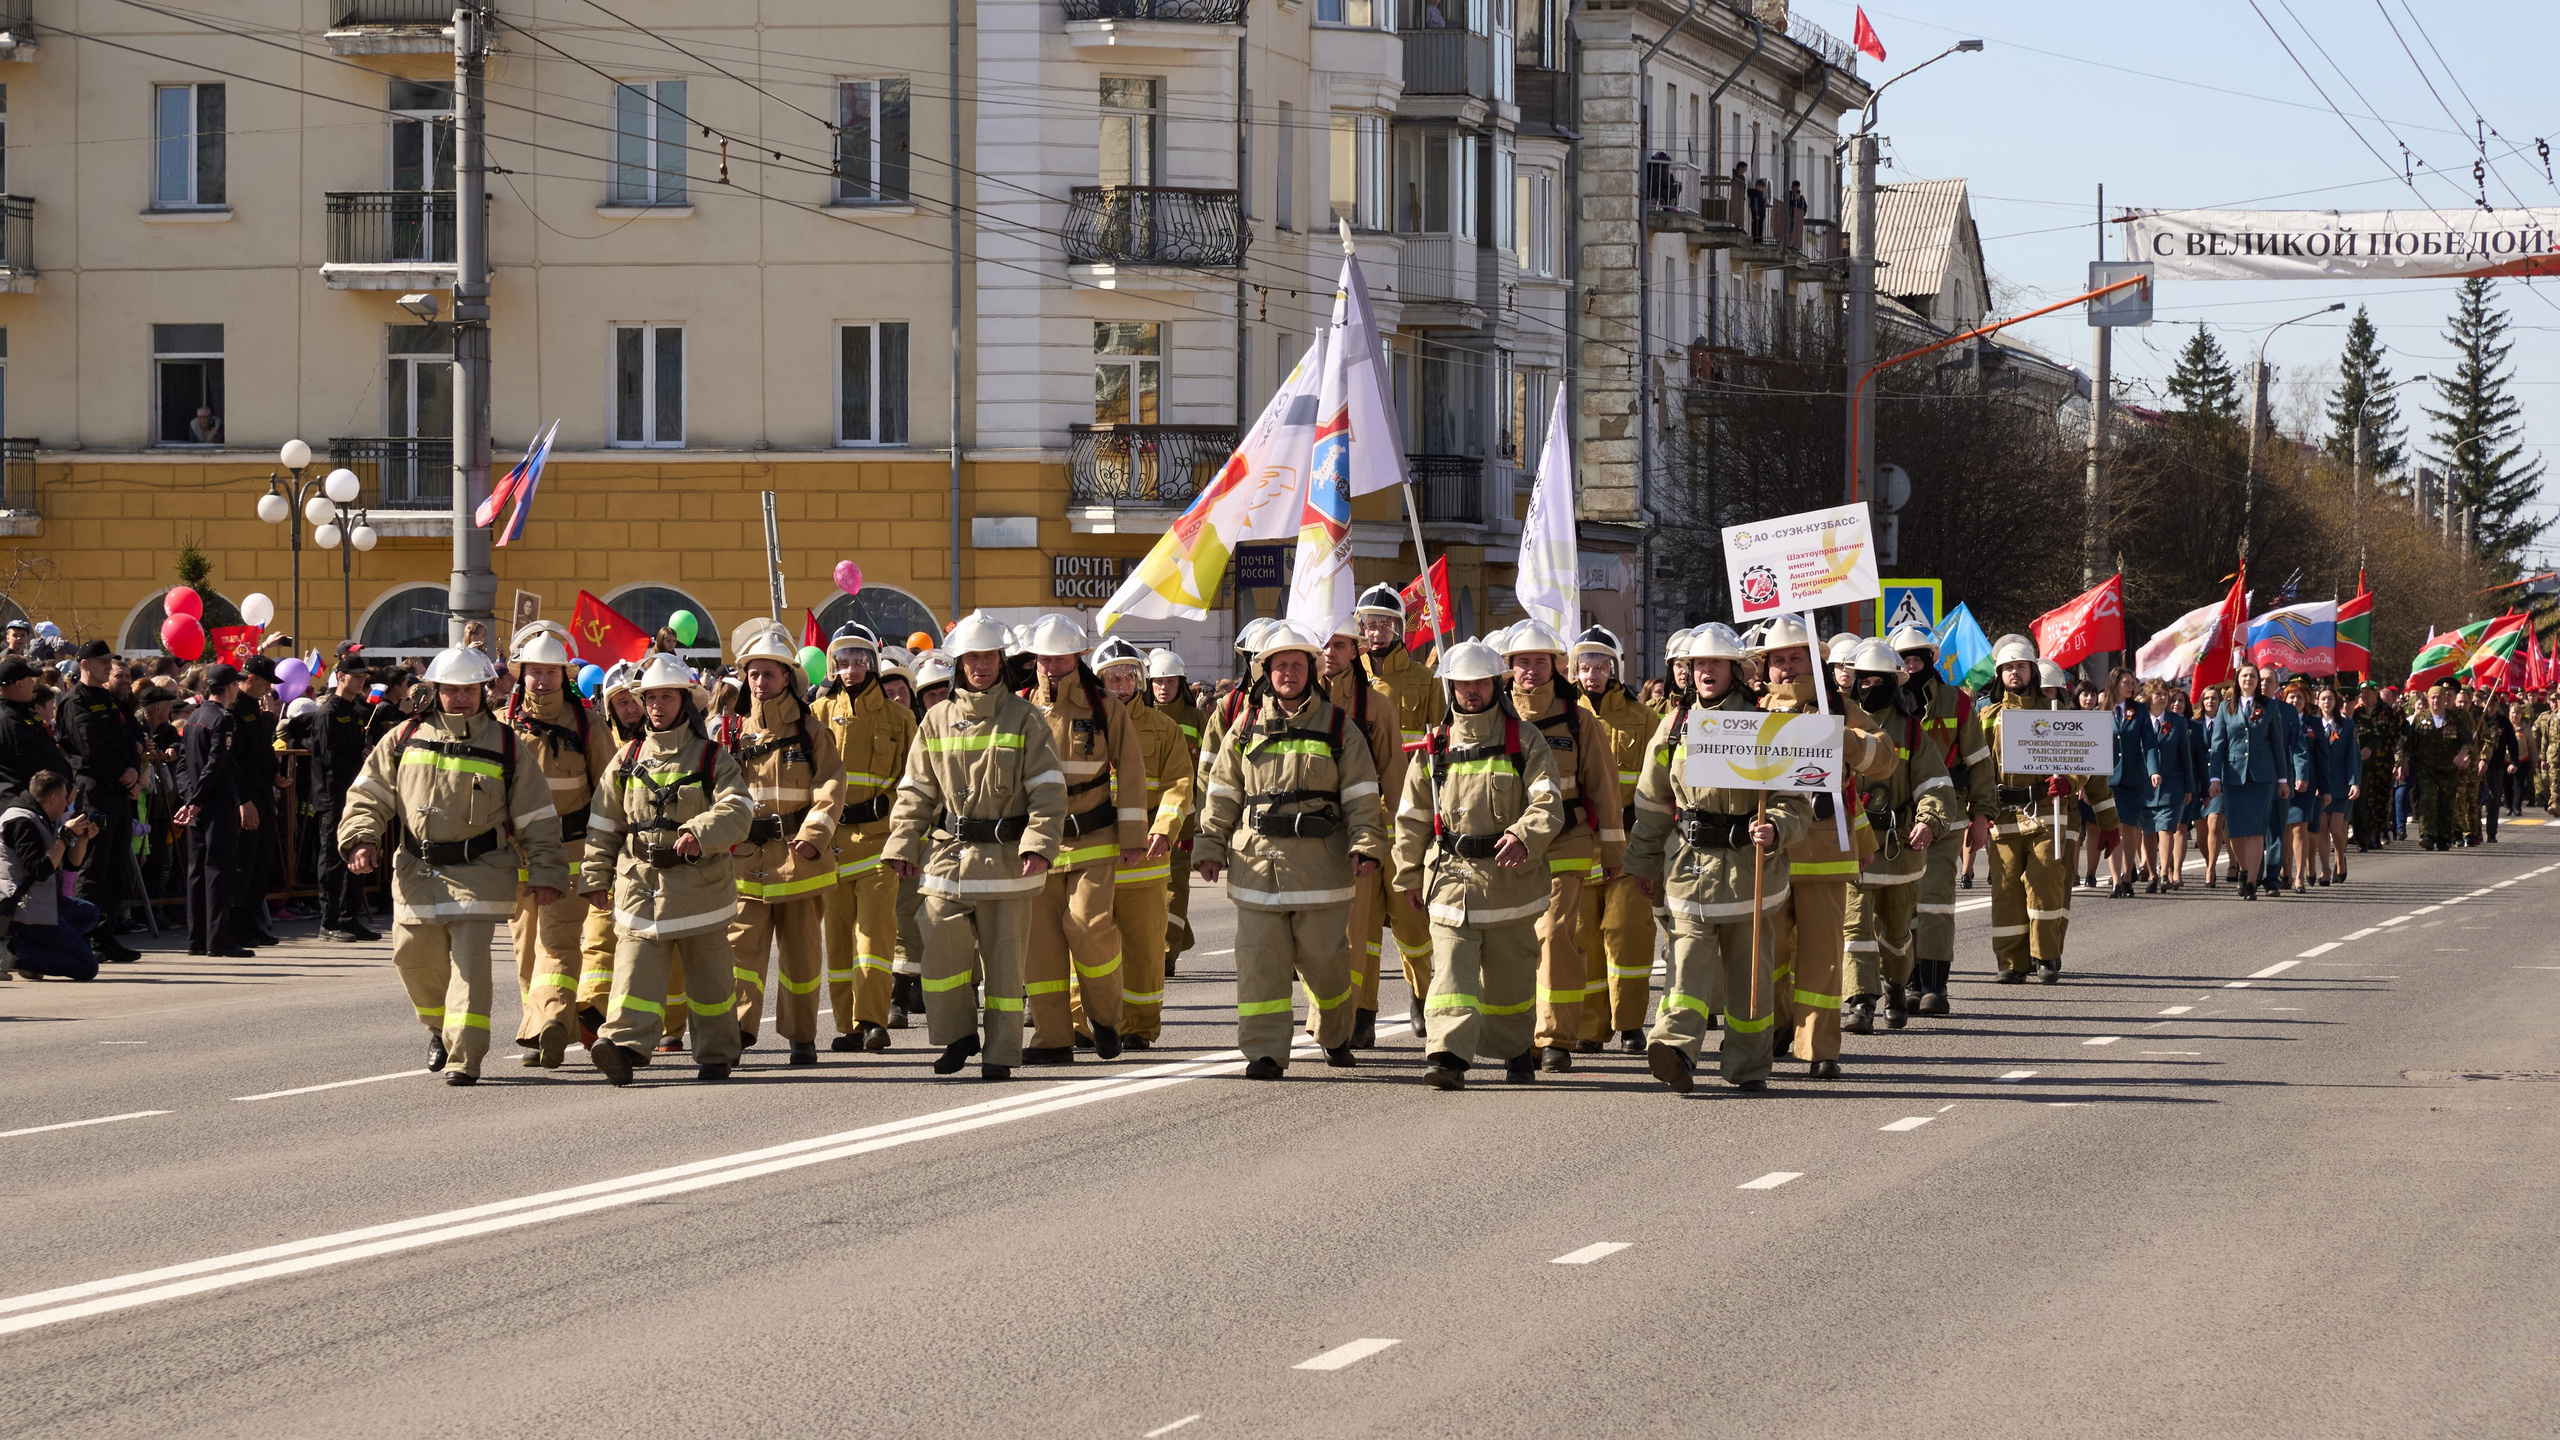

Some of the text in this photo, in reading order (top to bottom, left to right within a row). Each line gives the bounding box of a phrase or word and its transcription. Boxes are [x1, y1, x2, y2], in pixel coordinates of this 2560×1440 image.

[2153, 223, 2555, 262] С ВЕЛИКОЙ ПОБЕДОЙ!
[1754, 532, 1769, 543] АО
[1787, 542, 1865, 561] Шахтоуправление
[1055, 556, 1114, 576] ПОЧТА
[1240, 555, 1275, 566] ПОЧТА
[1788, 561, 1815, 570] имени
[1241, 568, 1275, 579] РОССИИ
[1789, 567, 1830, 580] Анатолия
[1055, 578, 1118, 598] РОССИИ
[1790, 574, 1848, 591] Дмитриевича
[1792, 588, 1822, 600] Рубана
[1723, 718, 1758, 730] СУЭК
[2052, 721, 2084, 731] СУЭК
[2018, 740, 2099, 748] ПРОИЗВОДСТВЕННО-
[1696, 743, 1833, 759] ЭНЕРГОУПРАВЛЕНИЕ
[2035, 764, 2096, 772] «СУЭК-Кузбасс»
